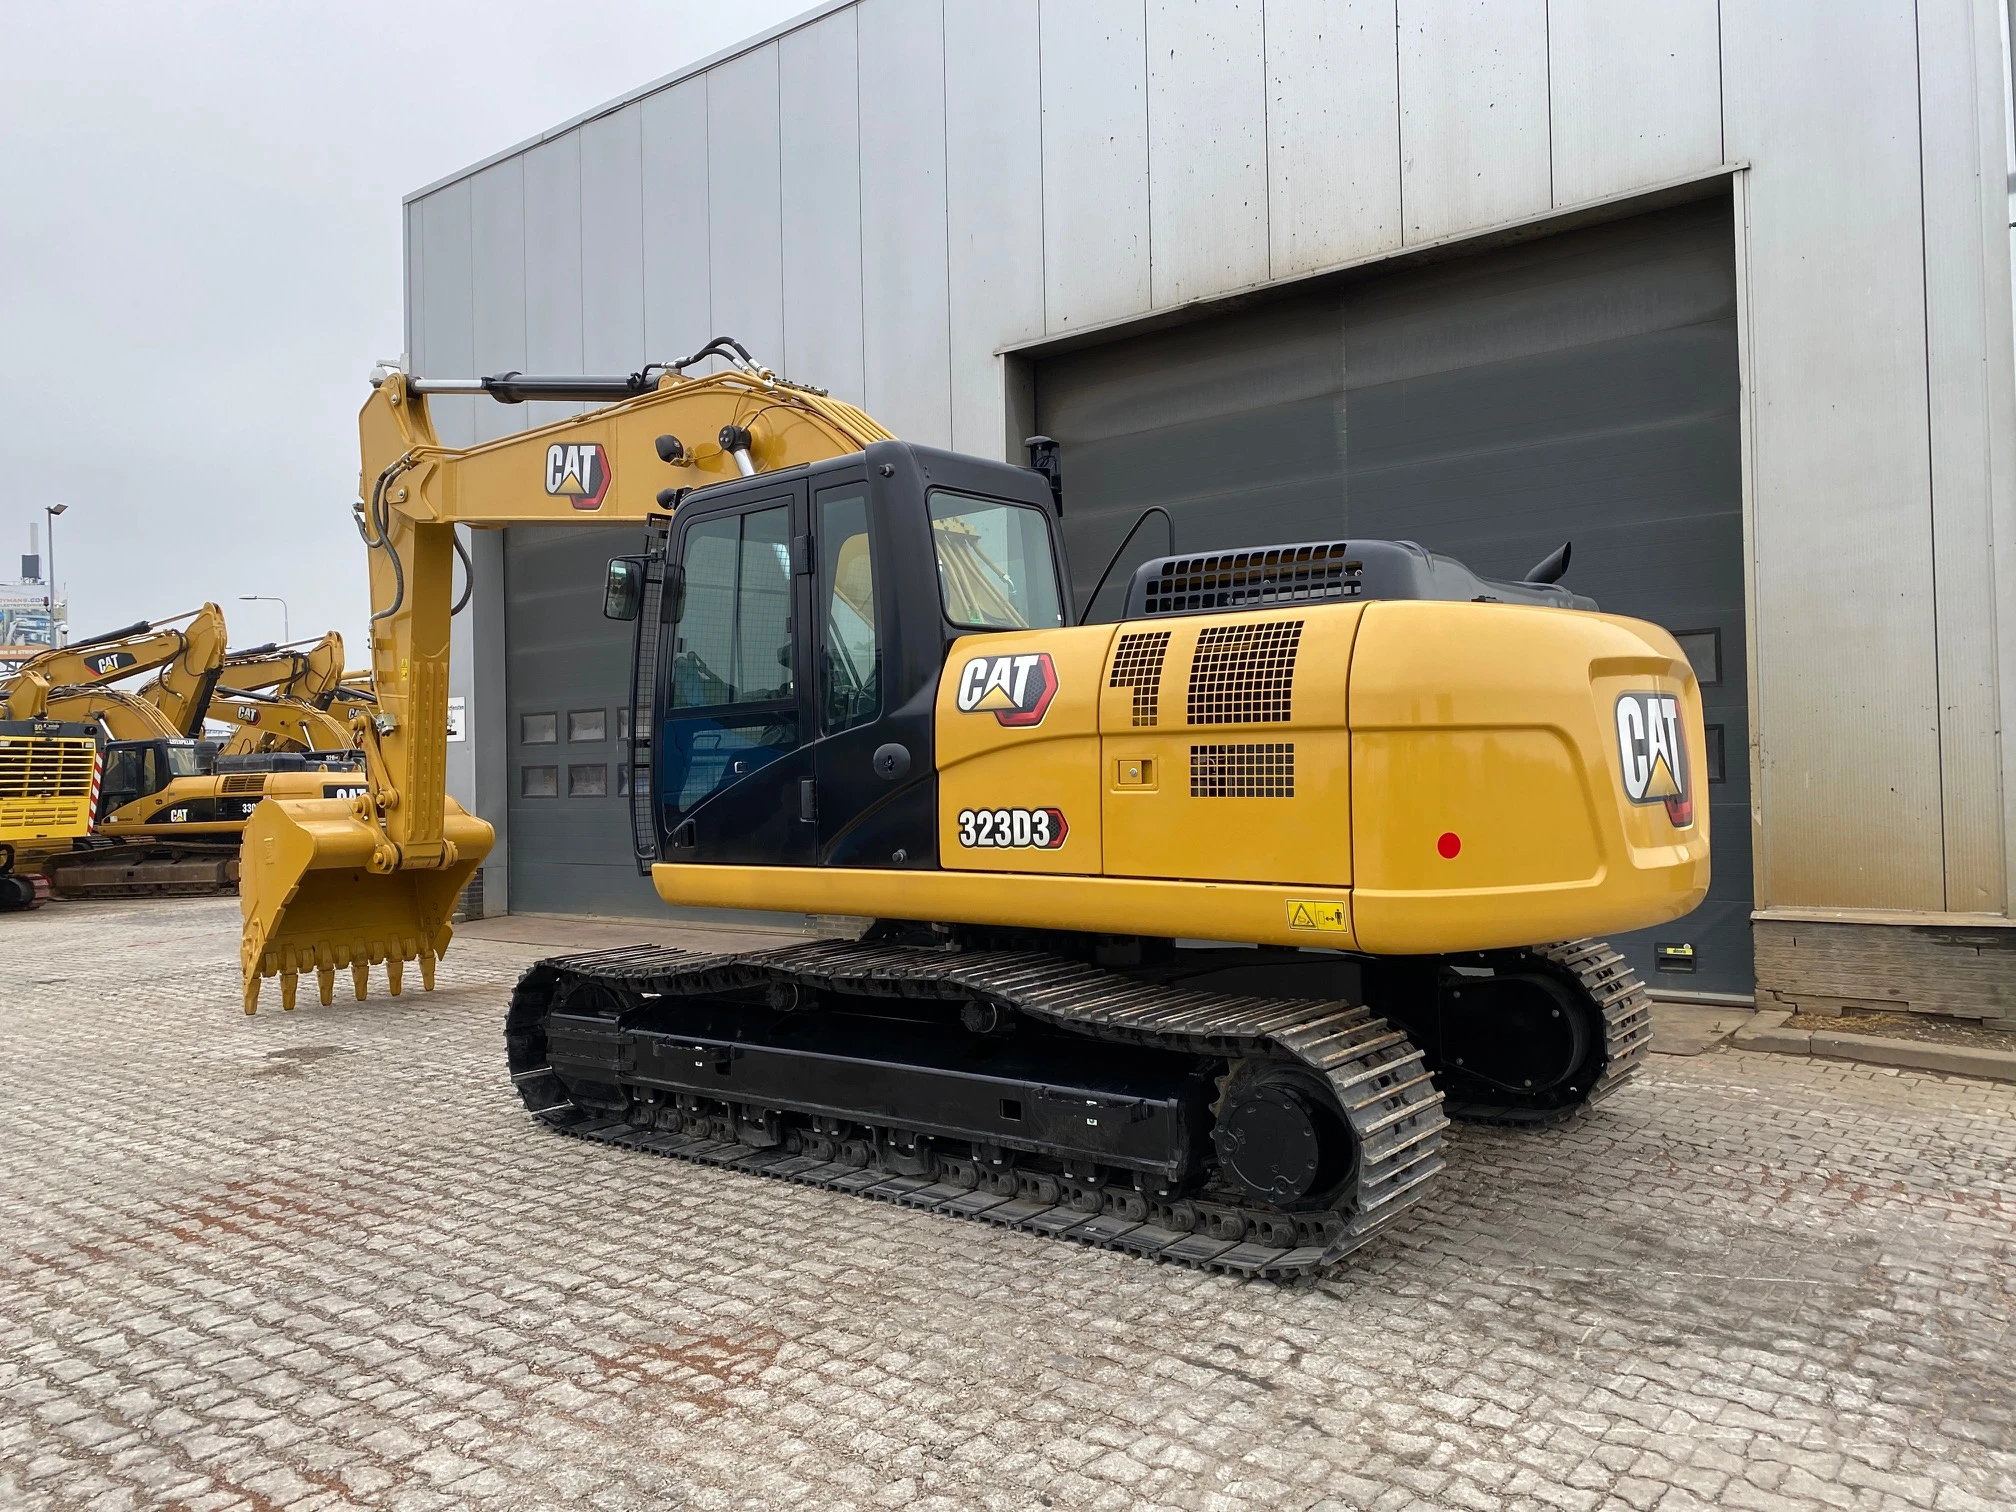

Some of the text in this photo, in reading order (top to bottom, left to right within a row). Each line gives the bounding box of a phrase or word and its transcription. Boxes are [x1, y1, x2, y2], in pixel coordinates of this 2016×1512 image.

[546, 444, 596, 494] CAT
[98, 653, 119, 674] CAT
[958, 654, 1040, 711] CAT
[237, 706, 257, 722] CAT
[1616, 696, 1683, 799] CAT
[170, 809, 188, 822] CAT
[959, 809, 1050, 847] 323D3
